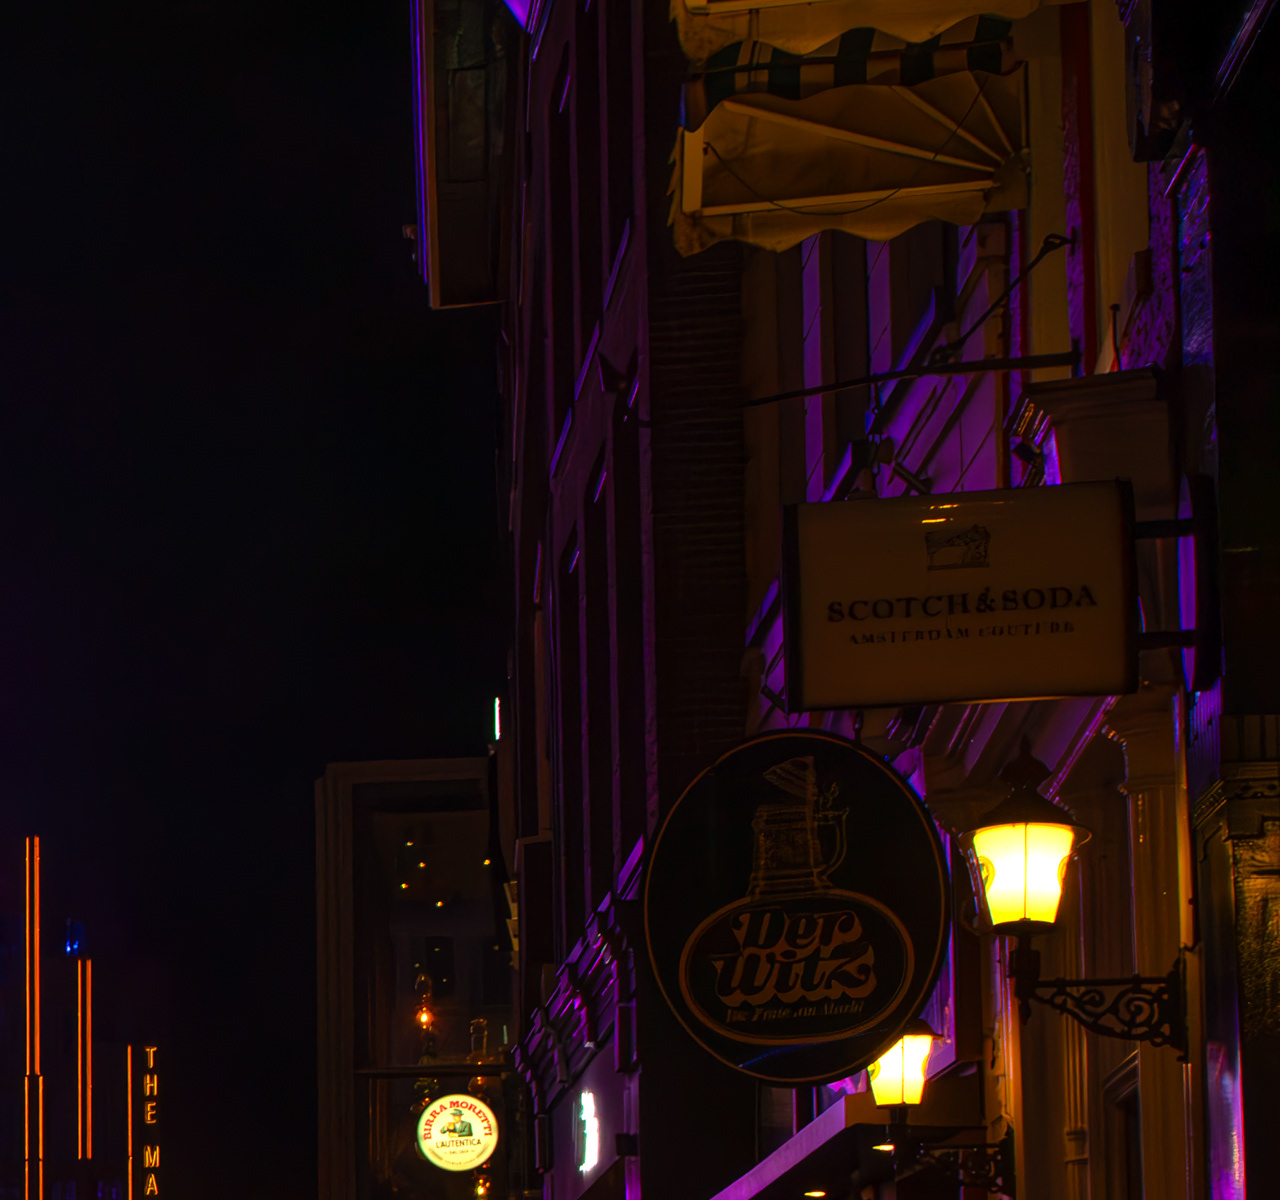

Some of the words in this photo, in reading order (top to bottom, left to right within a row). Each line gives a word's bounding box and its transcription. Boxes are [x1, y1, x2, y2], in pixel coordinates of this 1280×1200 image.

[848, 628, 970, 645] AMSTERDAM
[978, 621, 1076, 640] COUTURE
[730, 905, 863, 952] Der
[708, 941, 878, 1007] Witz
[144, 1046, 158, 1124] THE
[423, 1104, 447, 1140] BIRRA
[449, 1101, 492, 1136] MORETTI
